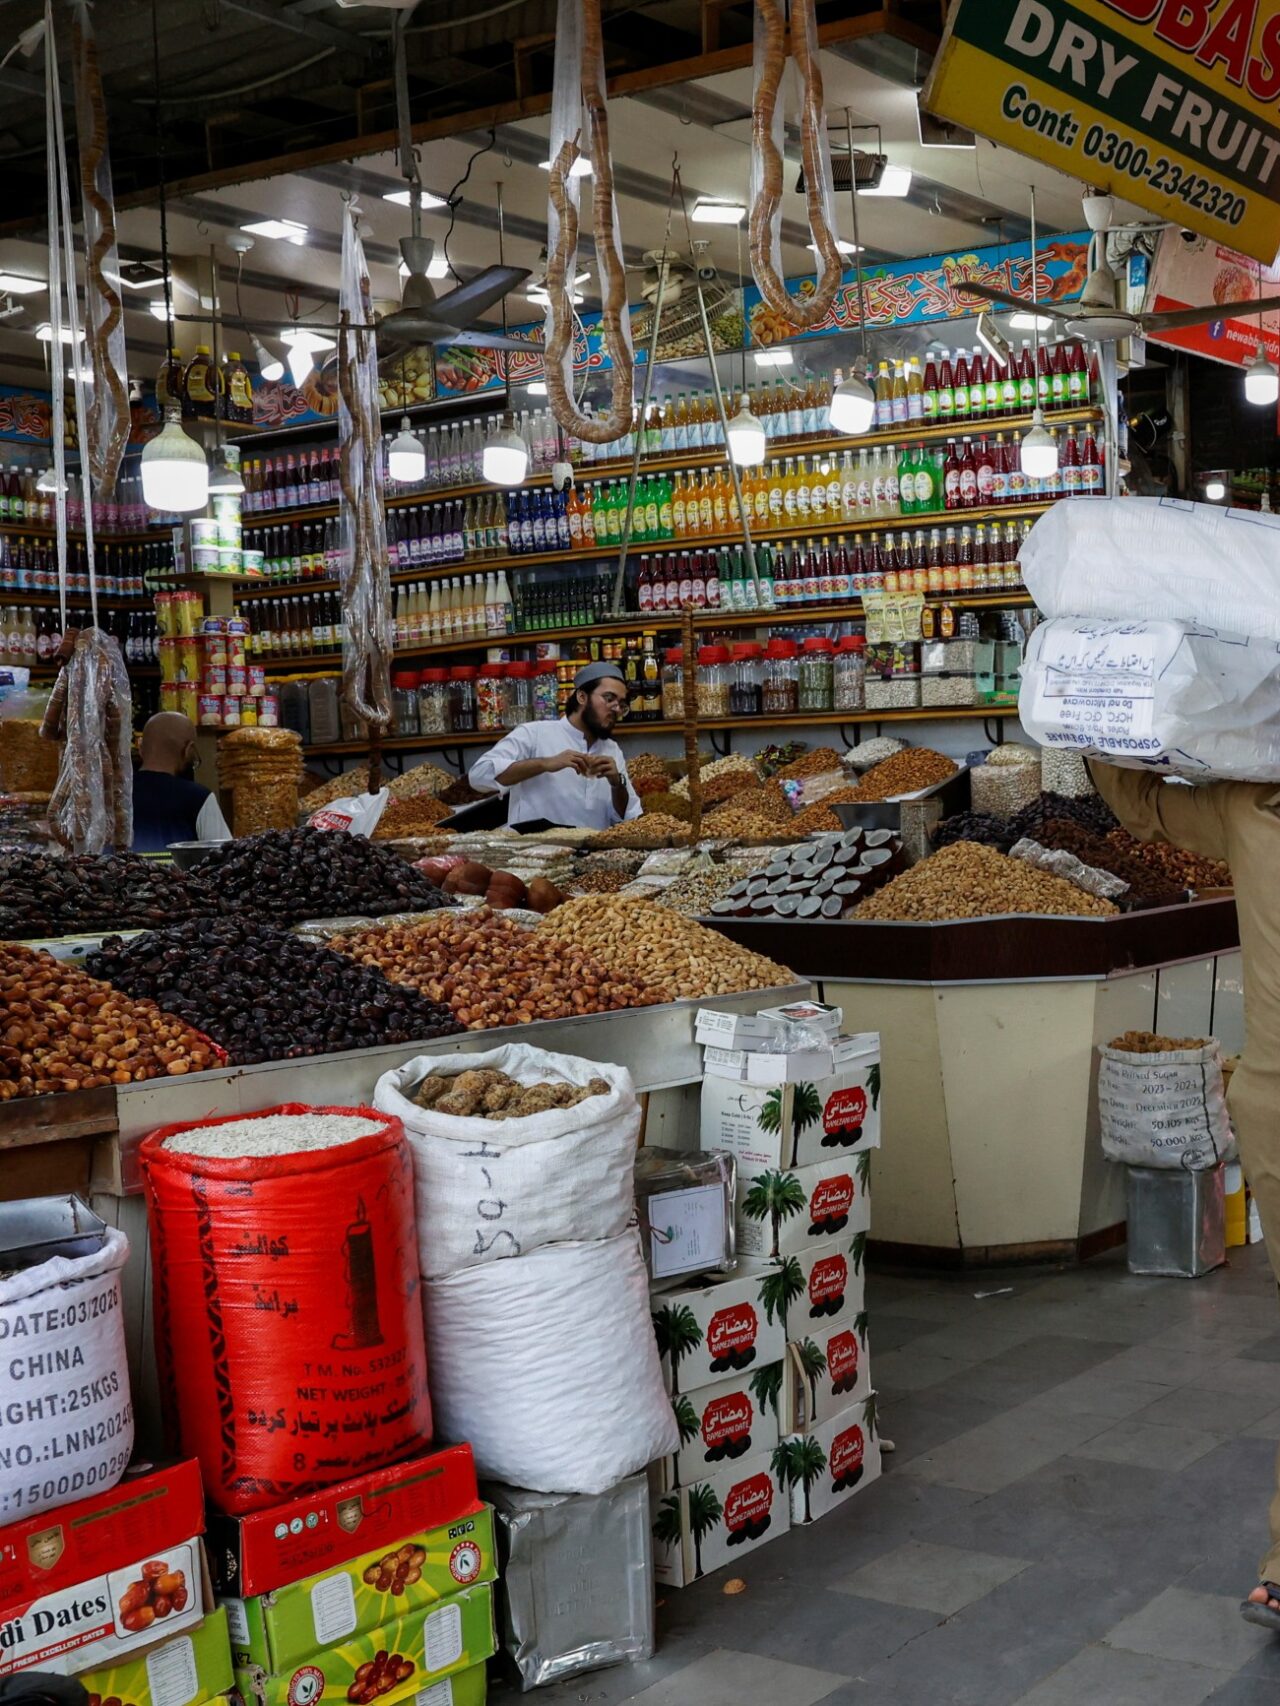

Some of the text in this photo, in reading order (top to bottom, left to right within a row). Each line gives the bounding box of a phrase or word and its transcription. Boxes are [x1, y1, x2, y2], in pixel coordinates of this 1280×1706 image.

[1003, 0, 1139, 99] DRY
[1001, 82, 1247, 225] Cont: 0300-2342320
[1059, 710, 1081, 721] Free
[1062, 698, 1106, 709] Microwave
[1122, 699, 1133, 709] Do
[9, 1345, 85, 1381] CHINA
[0, 1370, 119, 1428] GHT:25KGS
[296, 1381, 386, 1402] NET WEIGHT
[31, 1594, 107, 1638] Dates
